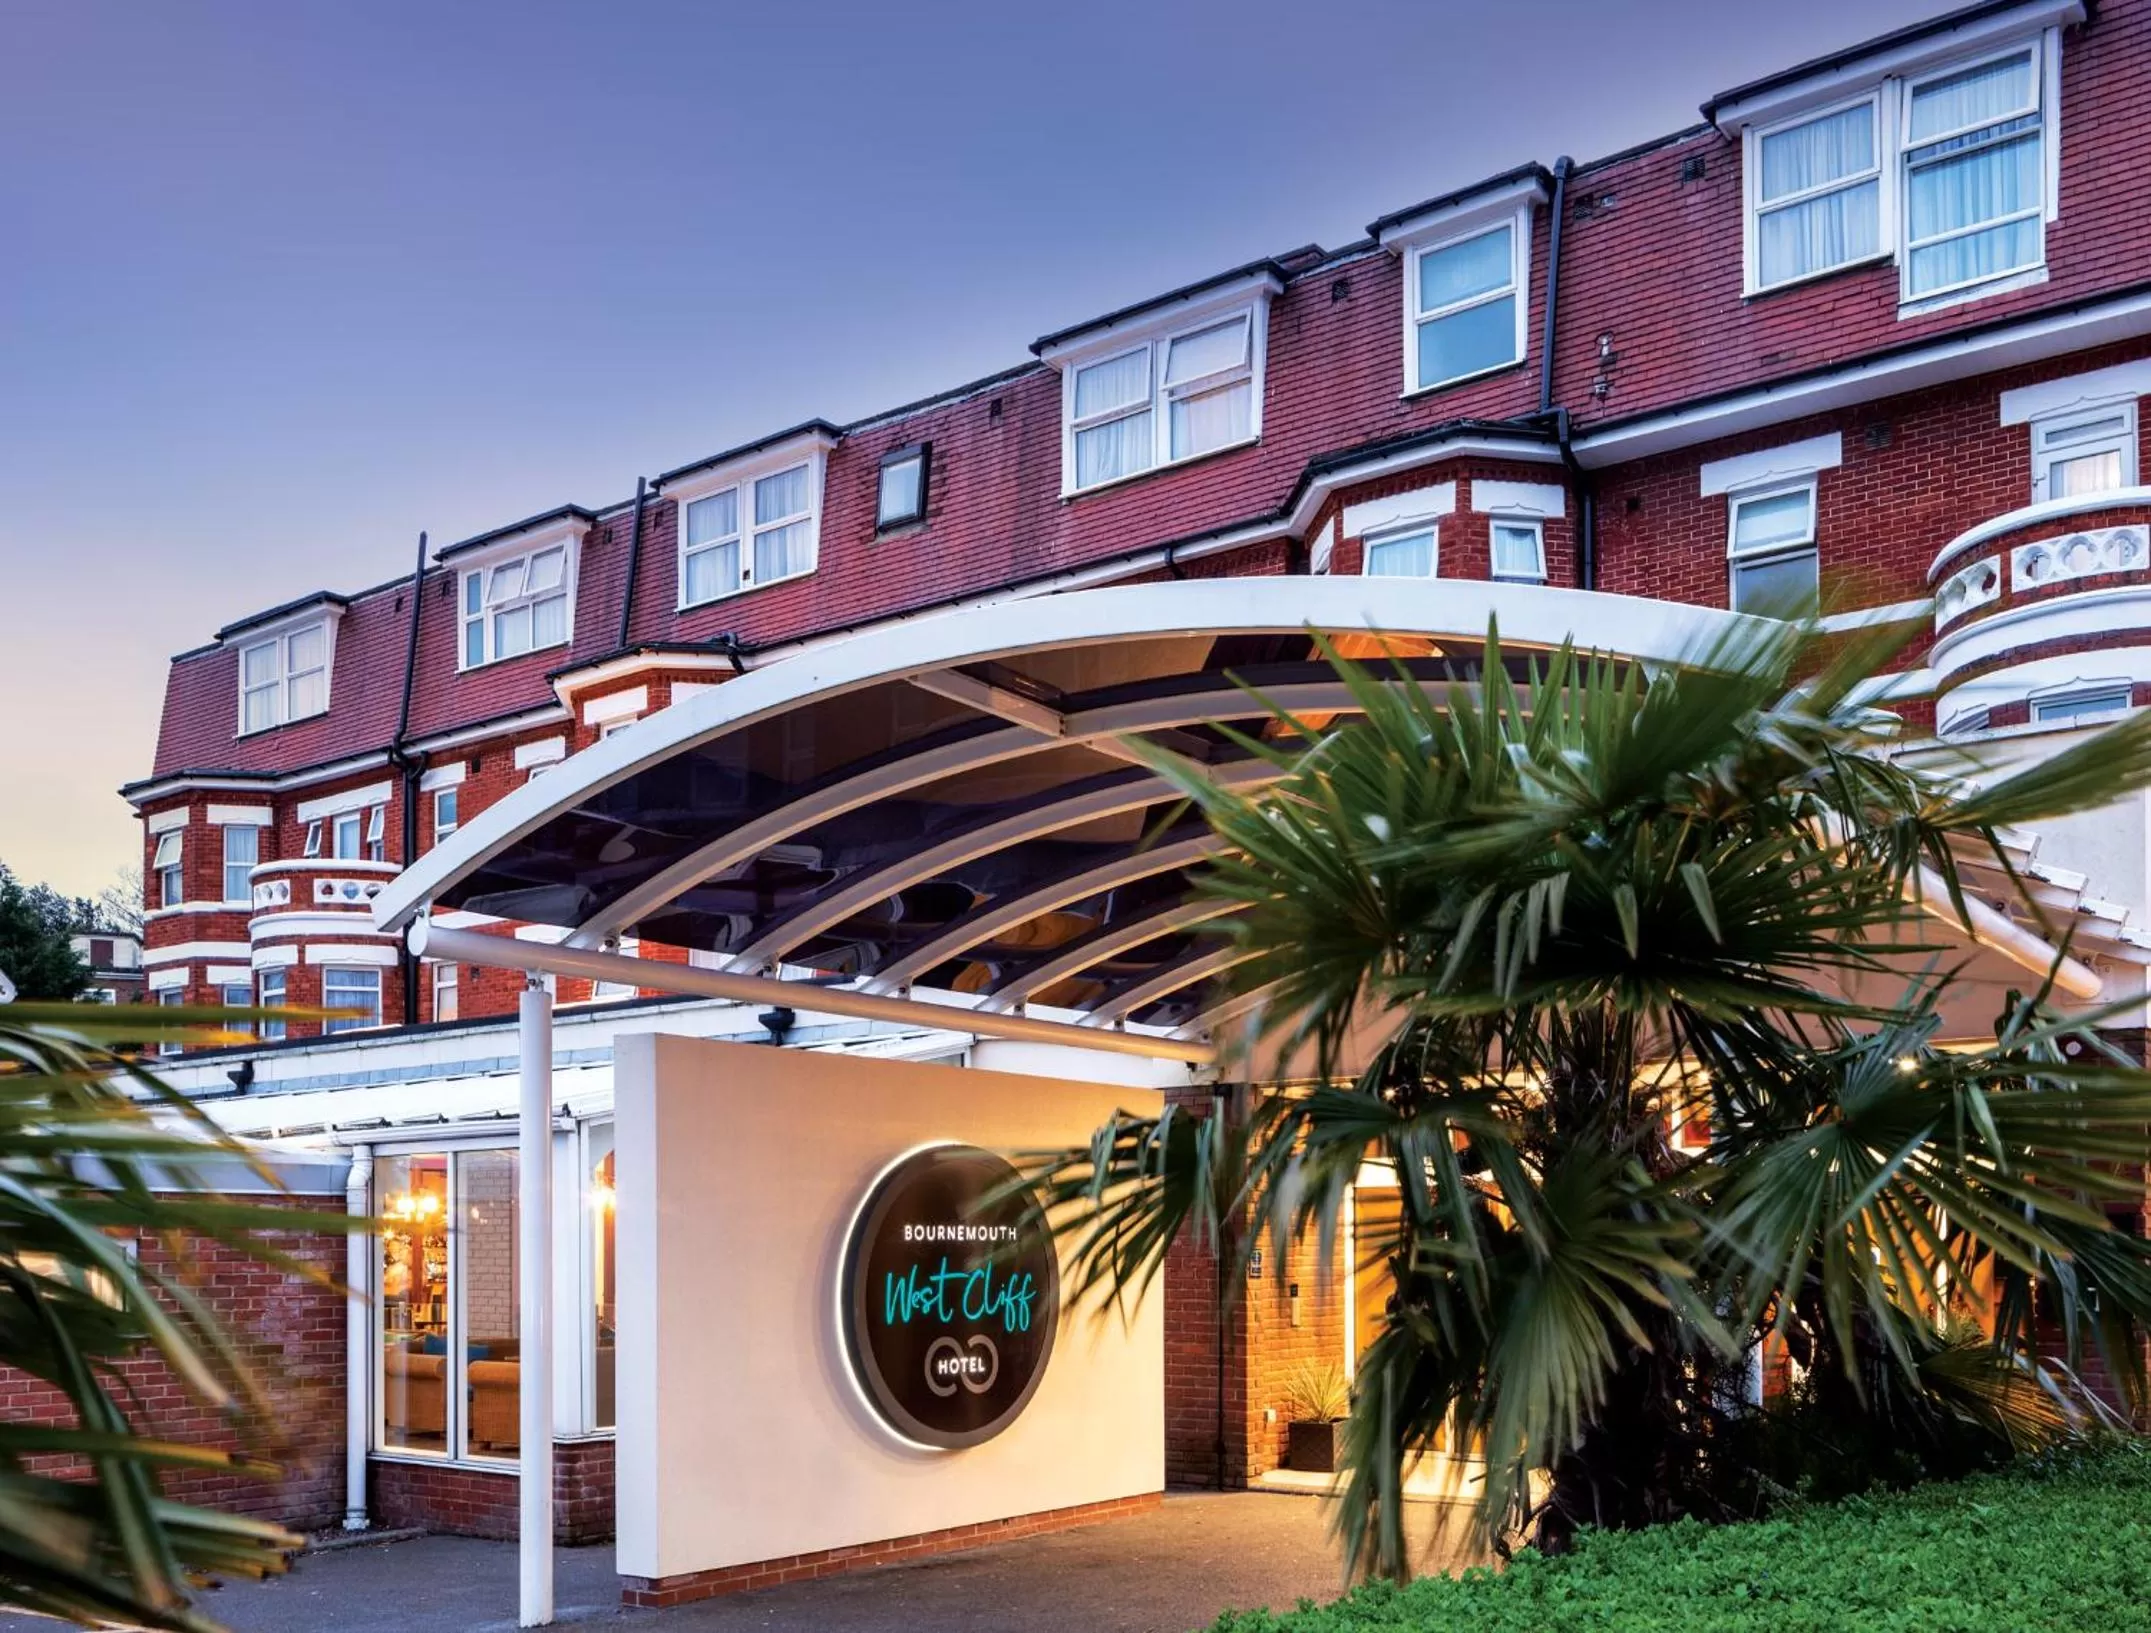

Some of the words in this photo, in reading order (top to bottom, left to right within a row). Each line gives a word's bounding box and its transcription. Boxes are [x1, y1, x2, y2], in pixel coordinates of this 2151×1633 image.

[904, 1225, 1017, 1241] BOURNEMOUTH
[885, 1256, 966, 1325] West
[963, 1260, 1036, 1331] Cliff
[938, 1358, 986, 1375] HOTEL
